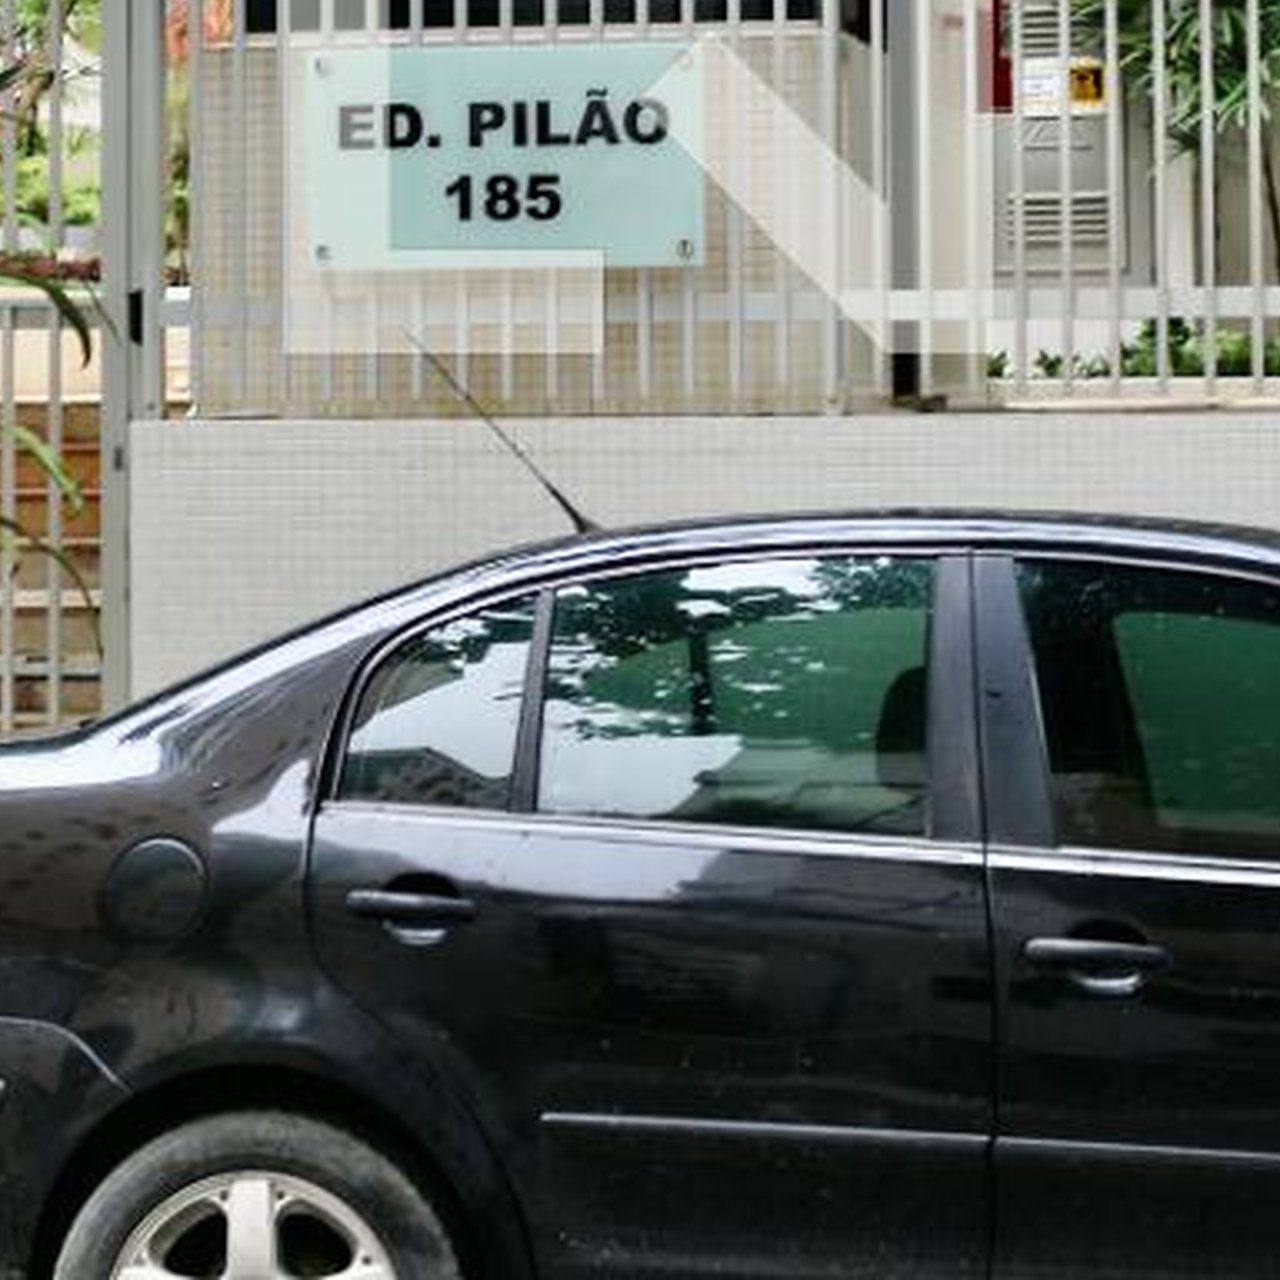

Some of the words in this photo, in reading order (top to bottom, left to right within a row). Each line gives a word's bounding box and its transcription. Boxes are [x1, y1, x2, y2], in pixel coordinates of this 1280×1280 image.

[338, 101, 442, 150] ED.
[467, 88, 670, 148] PILÃO
[445, 173, 563, 222] 185
